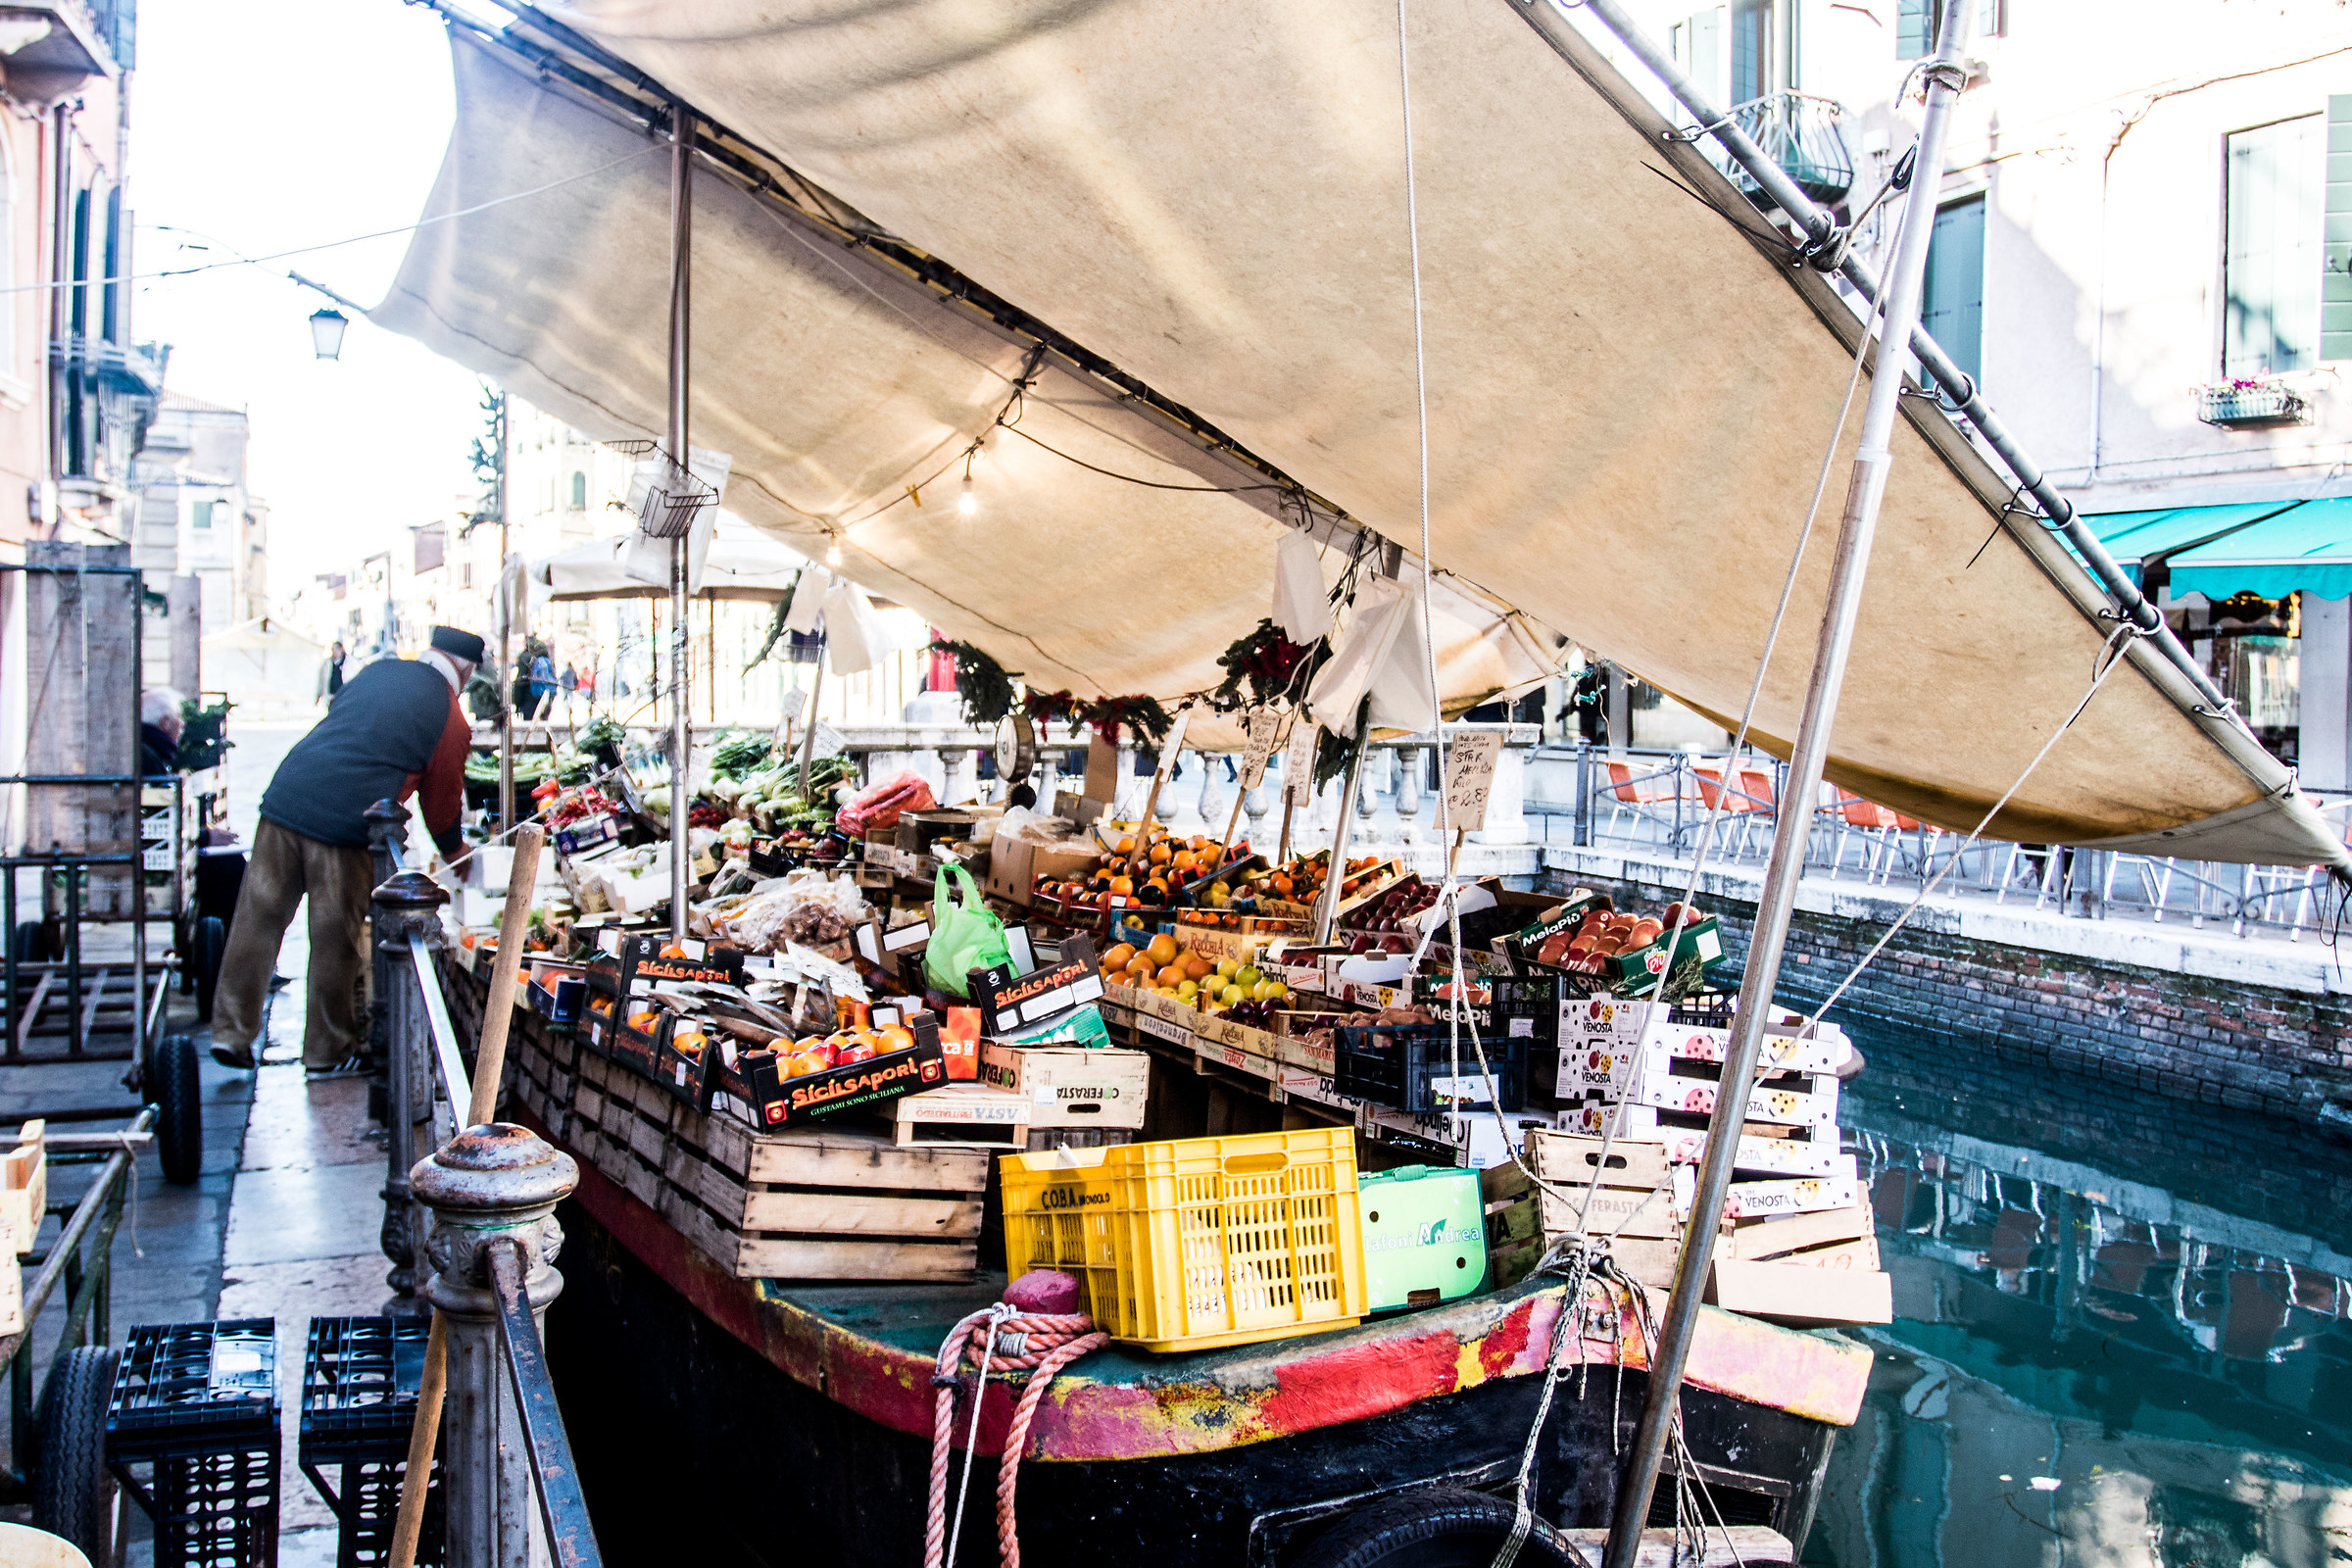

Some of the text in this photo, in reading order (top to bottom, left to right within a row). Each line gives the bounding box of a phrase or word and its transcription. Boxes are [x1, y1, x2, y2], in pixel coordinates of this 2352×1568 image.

[1355, 990, 1378, 1004] VENOSTA
[1583, 1022, 1613, 1033] VENOSTA
[1582, 1072, 1611, 1083] VENOSTA
[810, 1085, 906, 1116] GUSTAMI SONO SICILIANA
[975, 1107, 1018, 1120] ASTA
[1745, 1195, 1790, 1208] VENOSTA
[1416, 1221, 1479, 1247] Andrea
